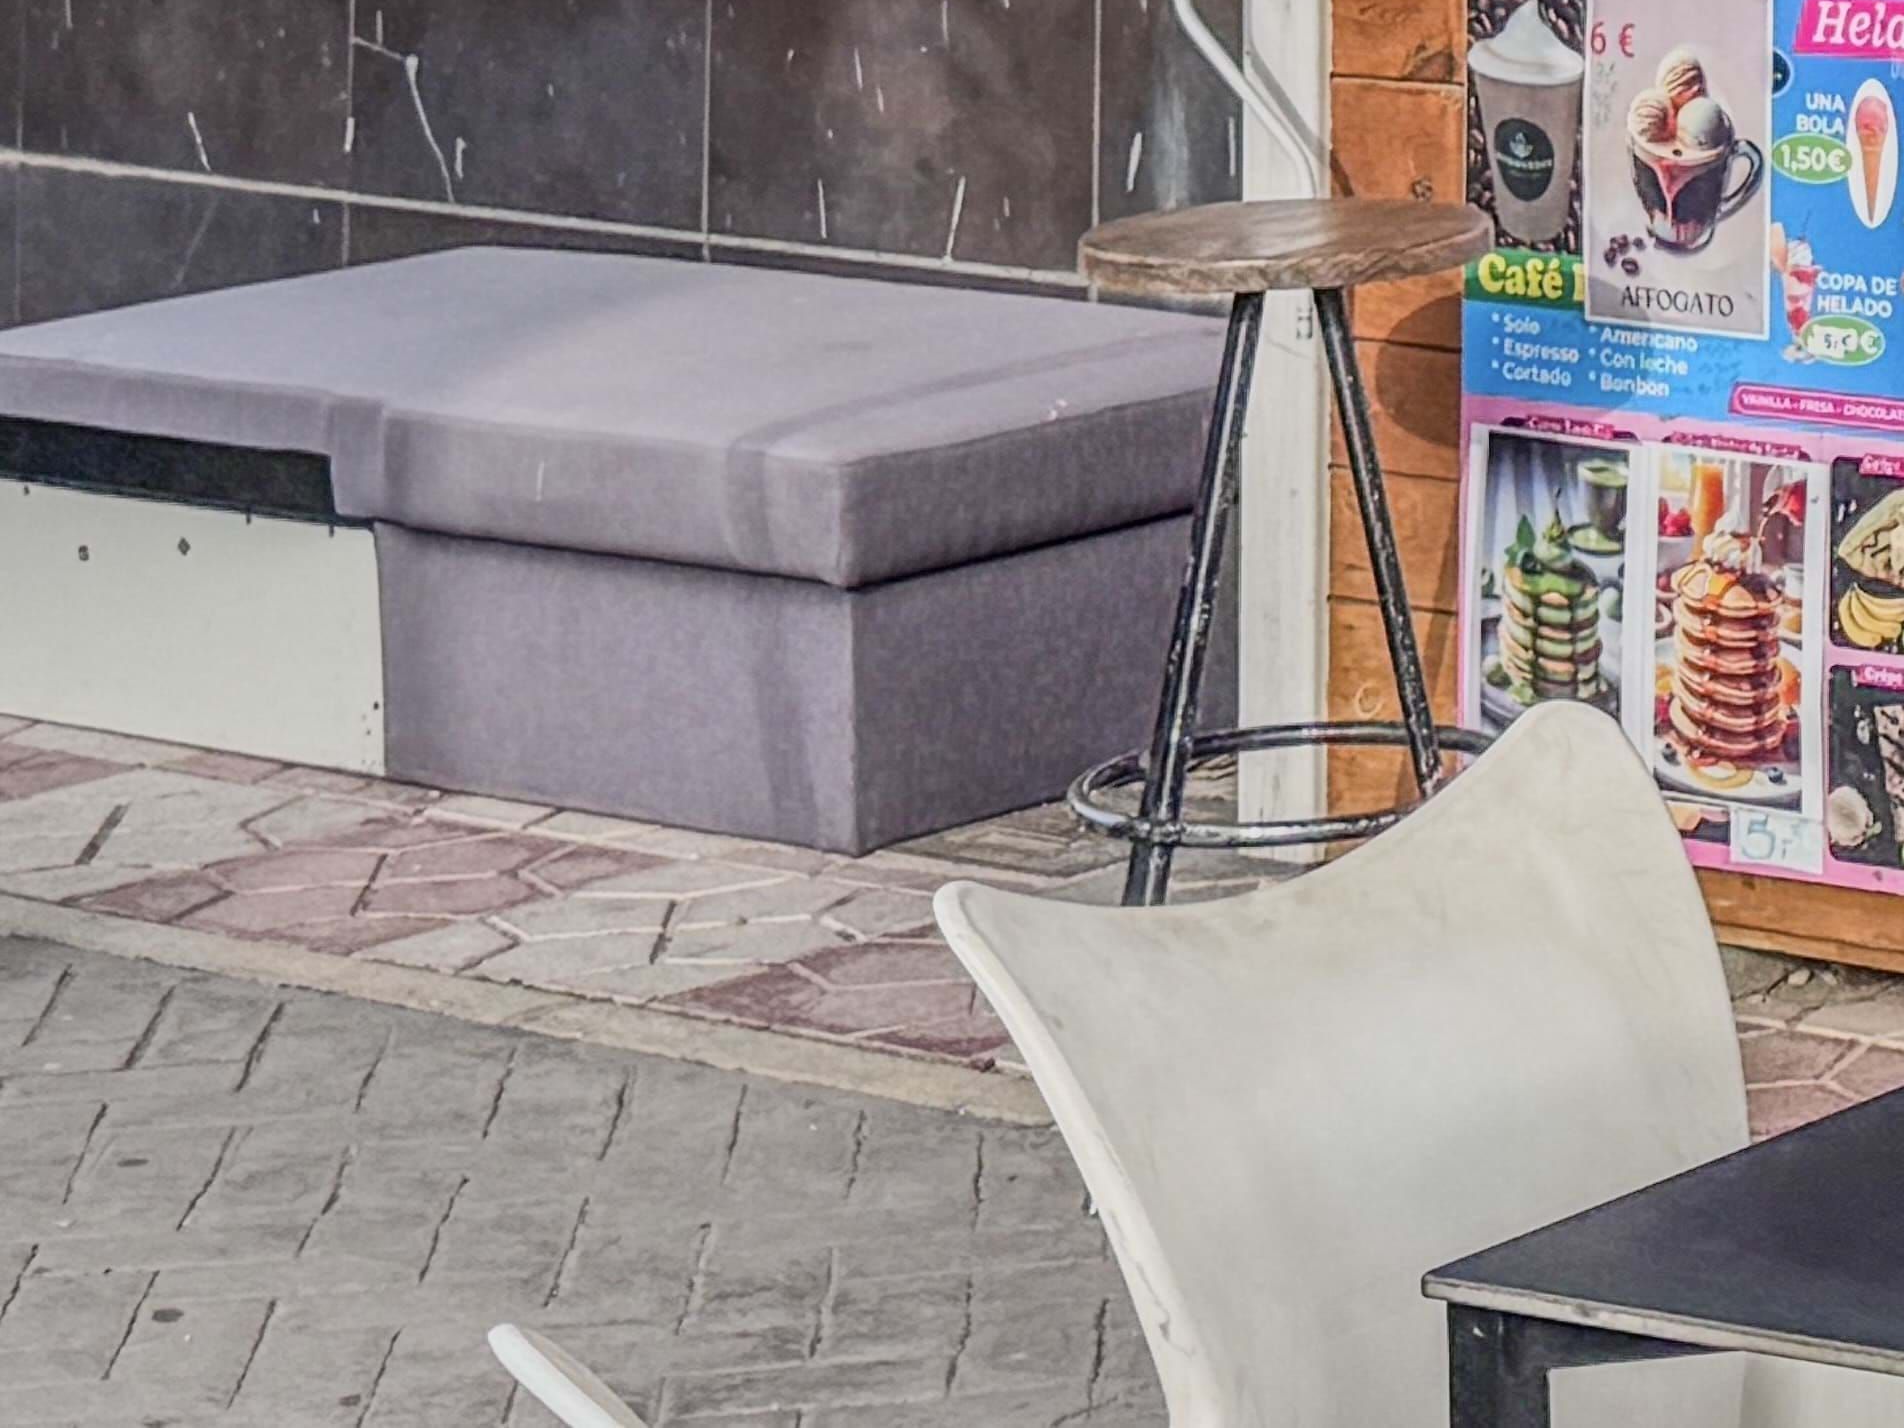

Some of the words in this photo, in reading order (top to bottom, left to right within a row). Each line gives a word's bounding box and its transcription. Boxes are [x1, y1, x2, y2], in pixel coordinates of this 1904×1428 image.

[1591, 22, 1607, 56] 6
[1618, 22, 1637, 58] €
[1805, 93, 1845, 113] UNA
[1796, 114, 1845, 135] BOLA
[1780, 145, 1847, 173] 1,50€
[1478, 252, 1564, 301] Café
[1816, 272, 1867, 293] COPA
[1871, 276, 1898, 296] DE
[1620, 285, 1734, 318] AFFOGATO
[1816, 294, 1894, 318] HELADO
[1503, 338, 1580, 364] Espresso
[1601, 326, 1698, 352] Americano
[1501, 362, 1572, 387] Cortado
[1601, 349, 1636, 370] Con
[1638, 352, 1689, 376] leche
